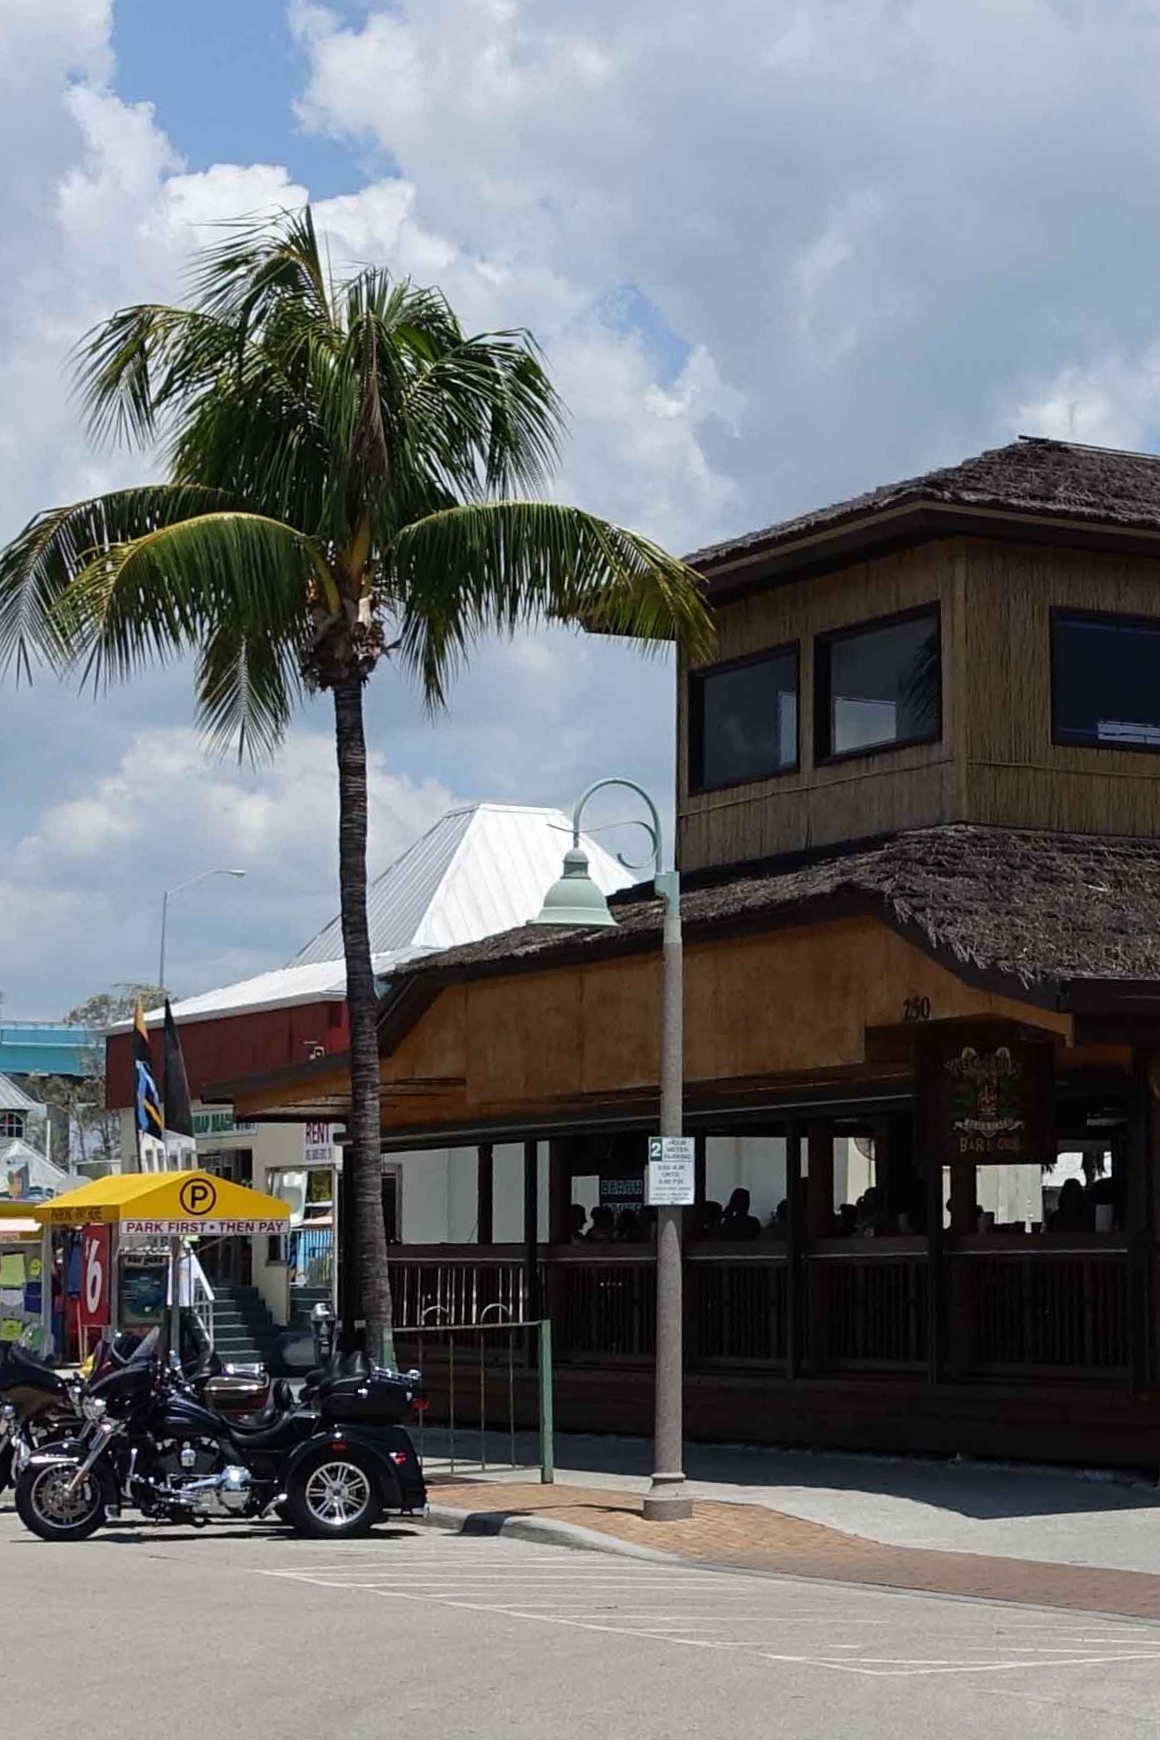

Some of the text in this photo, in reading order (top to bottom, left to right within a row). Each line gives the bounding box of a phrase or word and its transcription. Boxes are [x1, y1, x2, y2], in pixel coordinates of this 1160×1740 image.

[651, 1142, 662, 1157] 2
[958, 1136, 984, 1154] BAR
[191, 1185, 208, 1209] P
[126, 1221, 284, 1233] PARK FIRST THEN PAY
